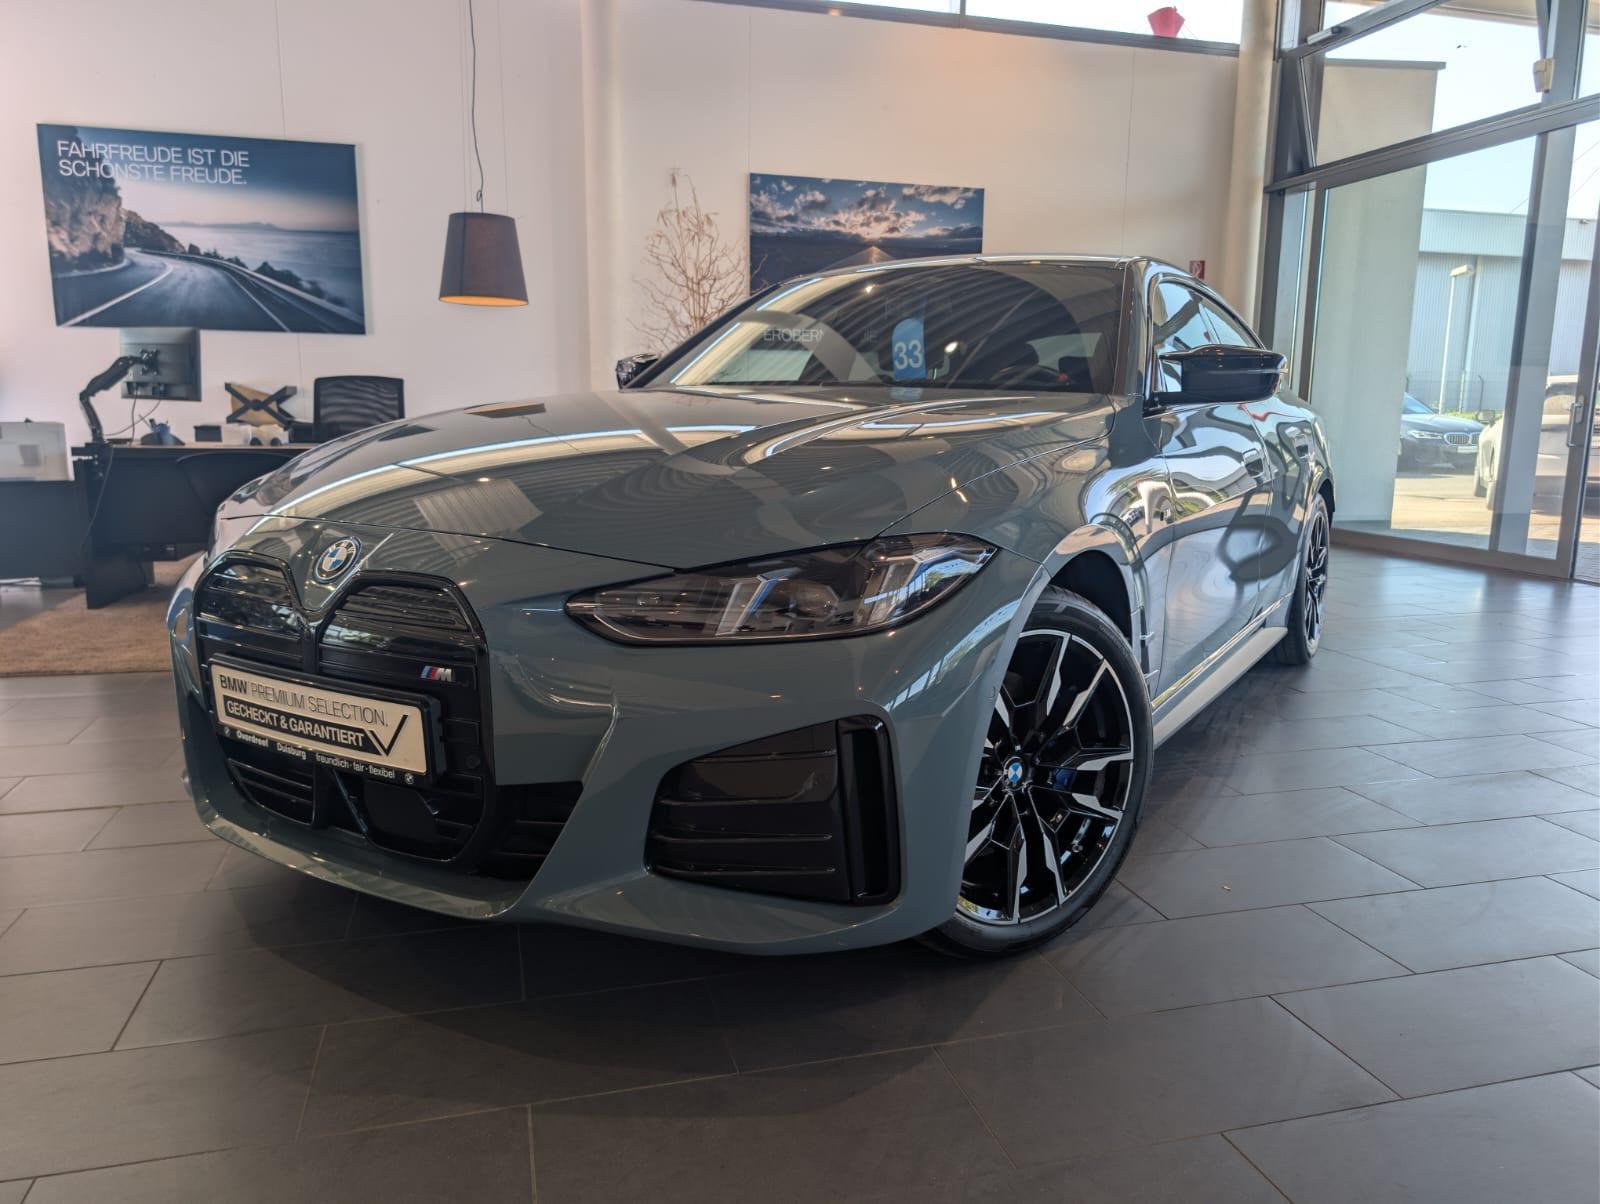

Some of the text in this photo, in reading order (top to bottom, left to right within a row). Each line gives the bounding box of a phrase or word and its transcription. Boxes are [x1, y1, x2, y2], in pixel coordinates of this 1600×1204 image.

[57, 140, 251, 168] FAHRFREUDE IST DIE
[170, 165, 248, 185] FREUDE.
[894, 339, 923, 370] 33
[219, 674, 389, 727] BMW PREMIUM SELECTION.
[226, 700, 364, 747] GECHECKT & GARANTIERT
[276, 742, 307, 760] Duisburg
